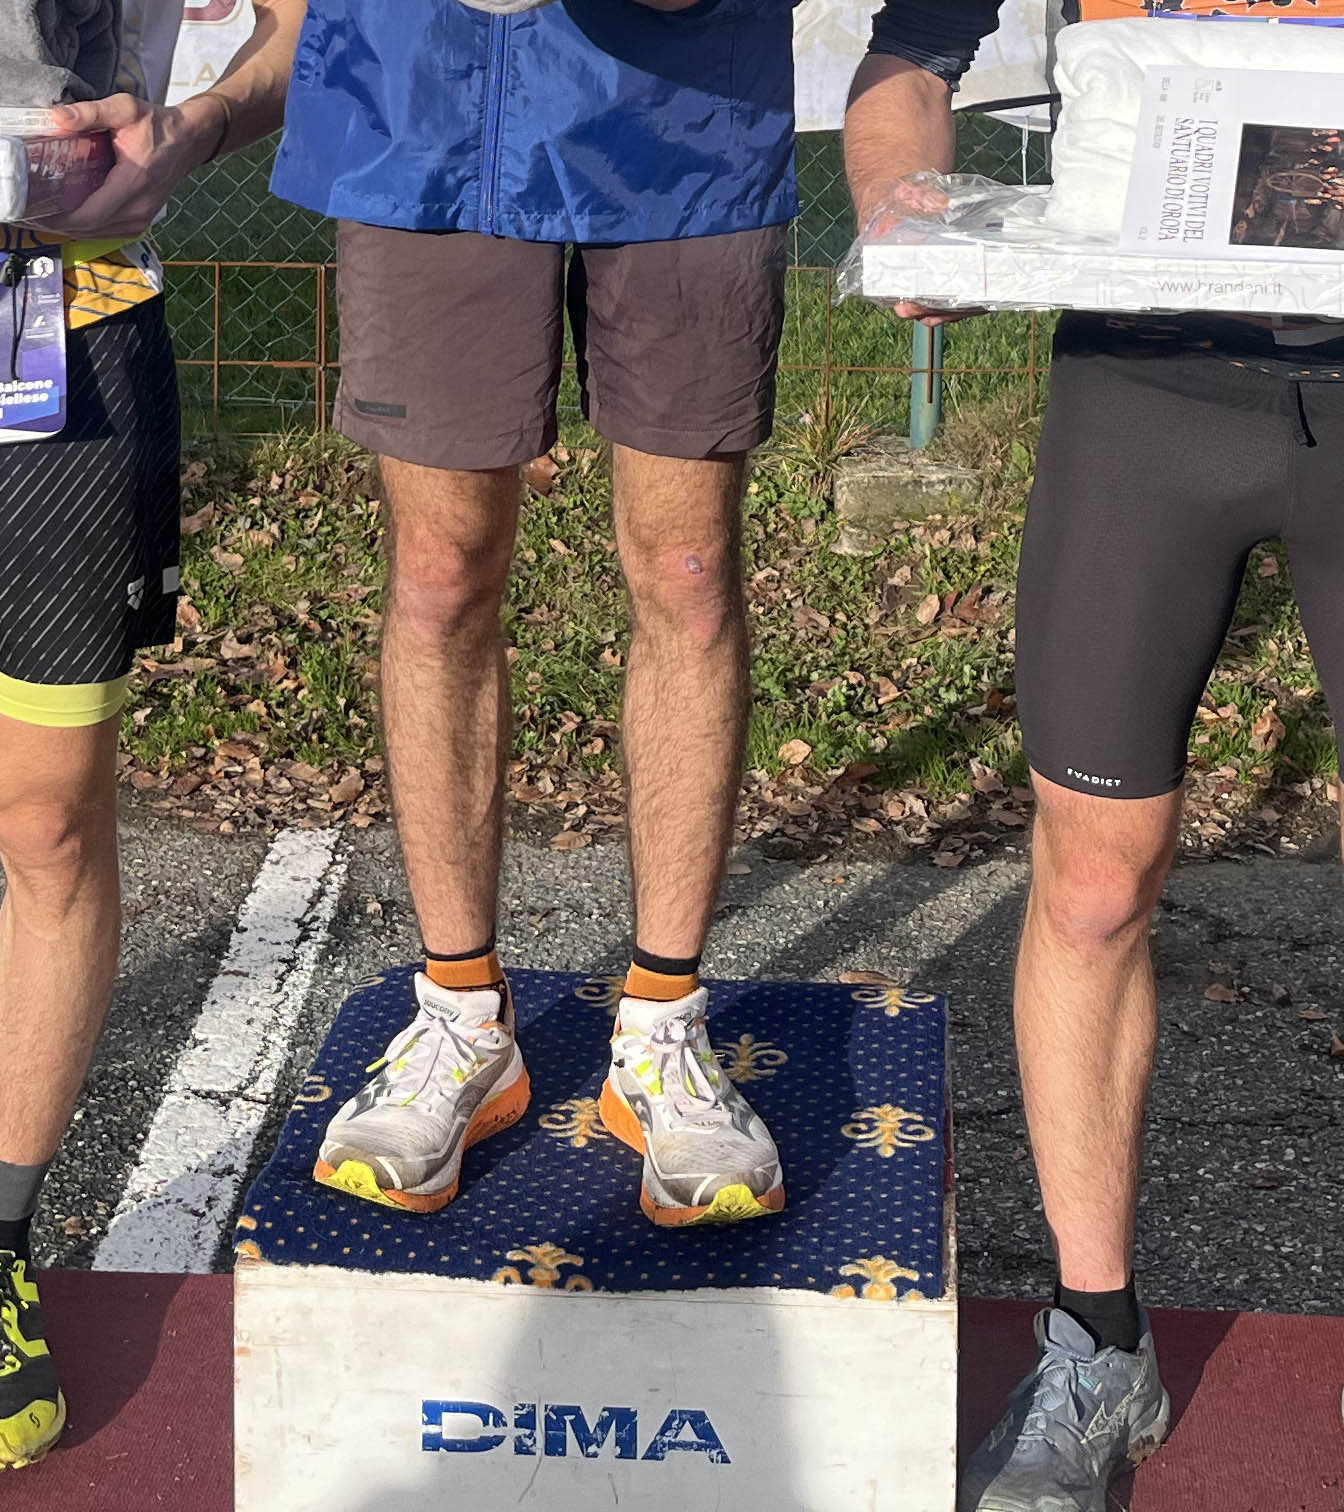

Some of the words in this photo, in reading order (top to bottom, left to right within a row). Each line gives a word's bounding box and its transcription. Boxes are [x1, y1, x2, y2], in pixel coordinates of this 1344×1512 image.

[1167, 117, 1194, 185] SANTUARIO
[1192, 126, 1217, 173] QUADRI
[1164, 187, 1185, 201] DI
[1187, 176, 1211, 217] VOTIVI
[1158, 202, 1182, 241] OROPA
[1183, 220, 1206, 243] DEL
[421, 1399, 732, 1465] DIMA
